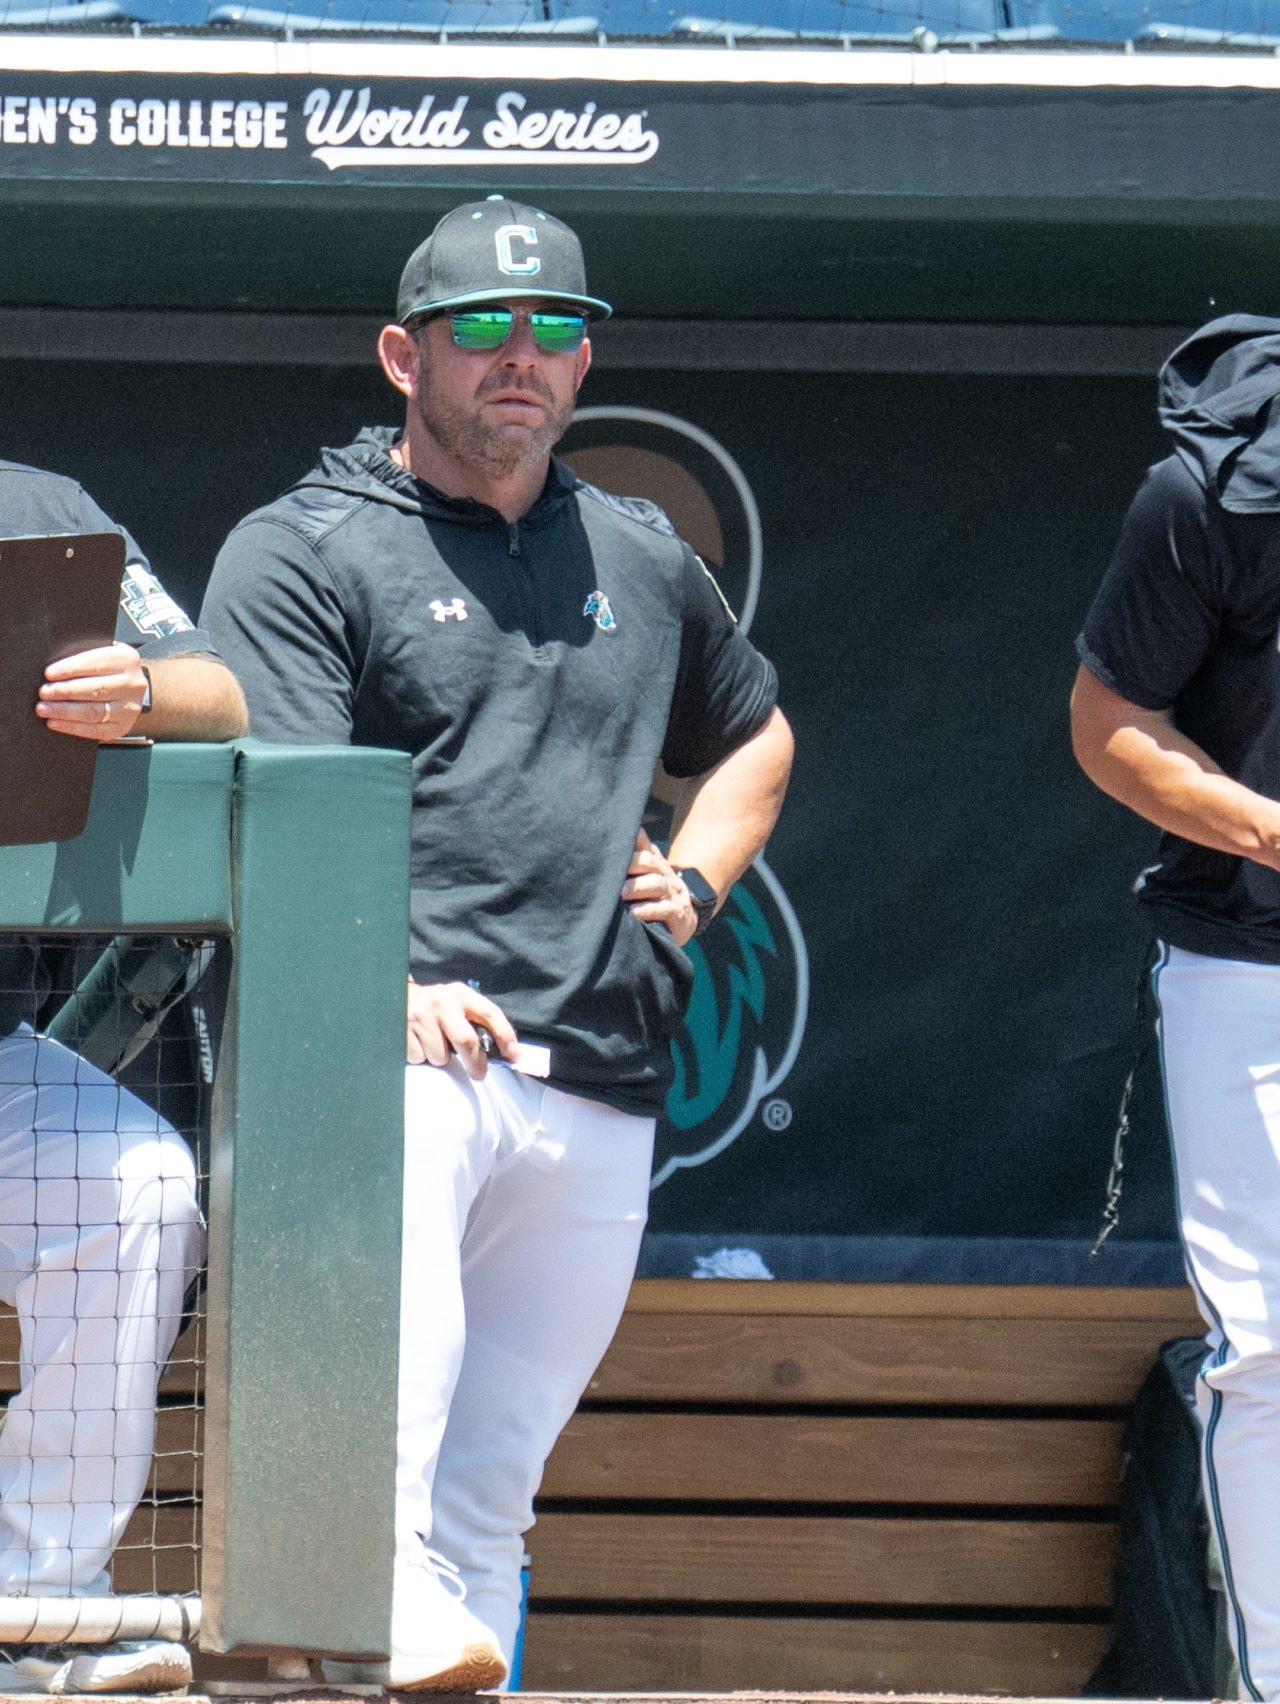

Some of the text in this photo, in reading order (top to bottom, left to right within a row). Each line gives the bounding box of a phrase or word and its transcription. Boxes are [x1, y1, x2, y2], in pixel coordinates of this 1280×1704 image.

[109, 98, 288, 148] COLLEGE
[303, 87, 470, 147] World
[482, 91, 658, 152] Series
[495, 225, 541, 275] C
